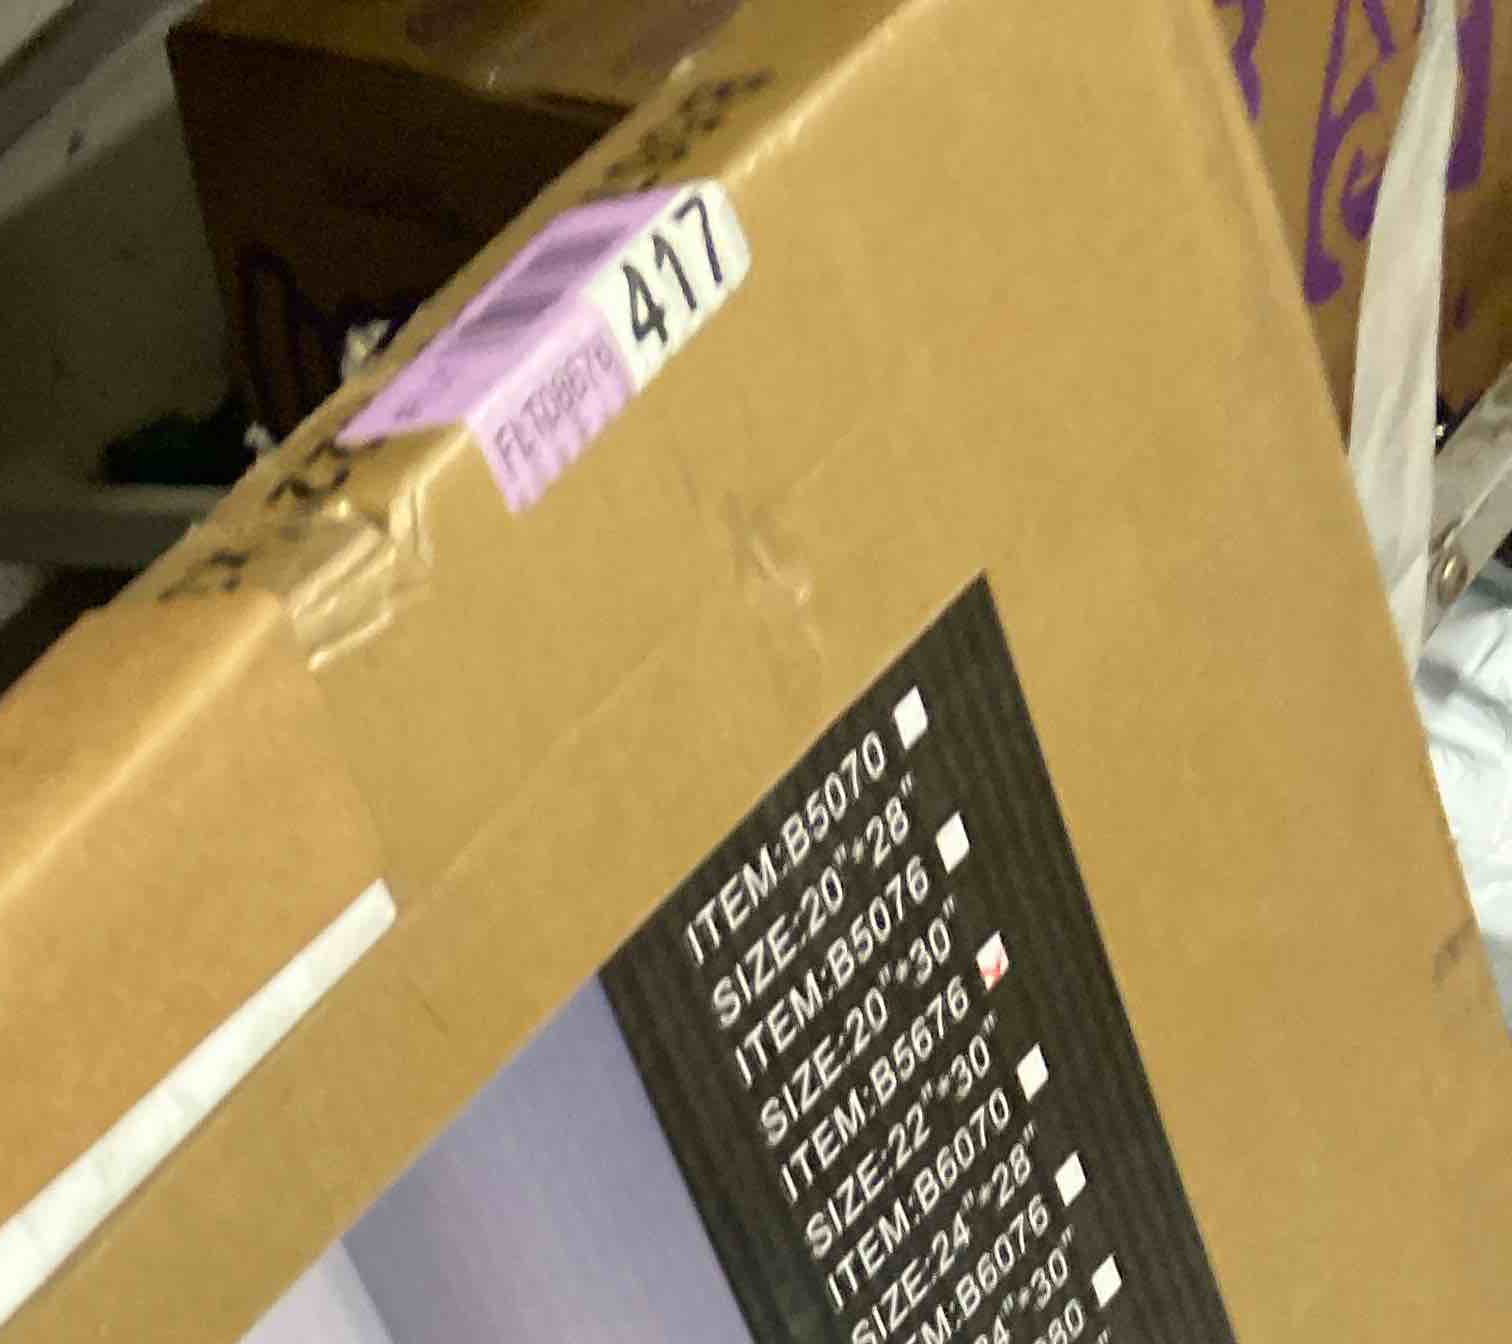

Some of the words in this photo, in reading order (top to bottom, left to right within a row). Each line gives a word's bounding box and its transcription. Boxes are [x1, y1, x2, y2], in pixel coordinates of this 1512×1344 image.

[619, 196, 724, 349] 417
[685, 730, 886, 965] ITEM:B5070
[734, 855, 929, 1088] ITEM:B5076
[780, 974, 969, 1204] ITEM:B5676
[827, 1086, 1010, 1313] ITEM:B6070
